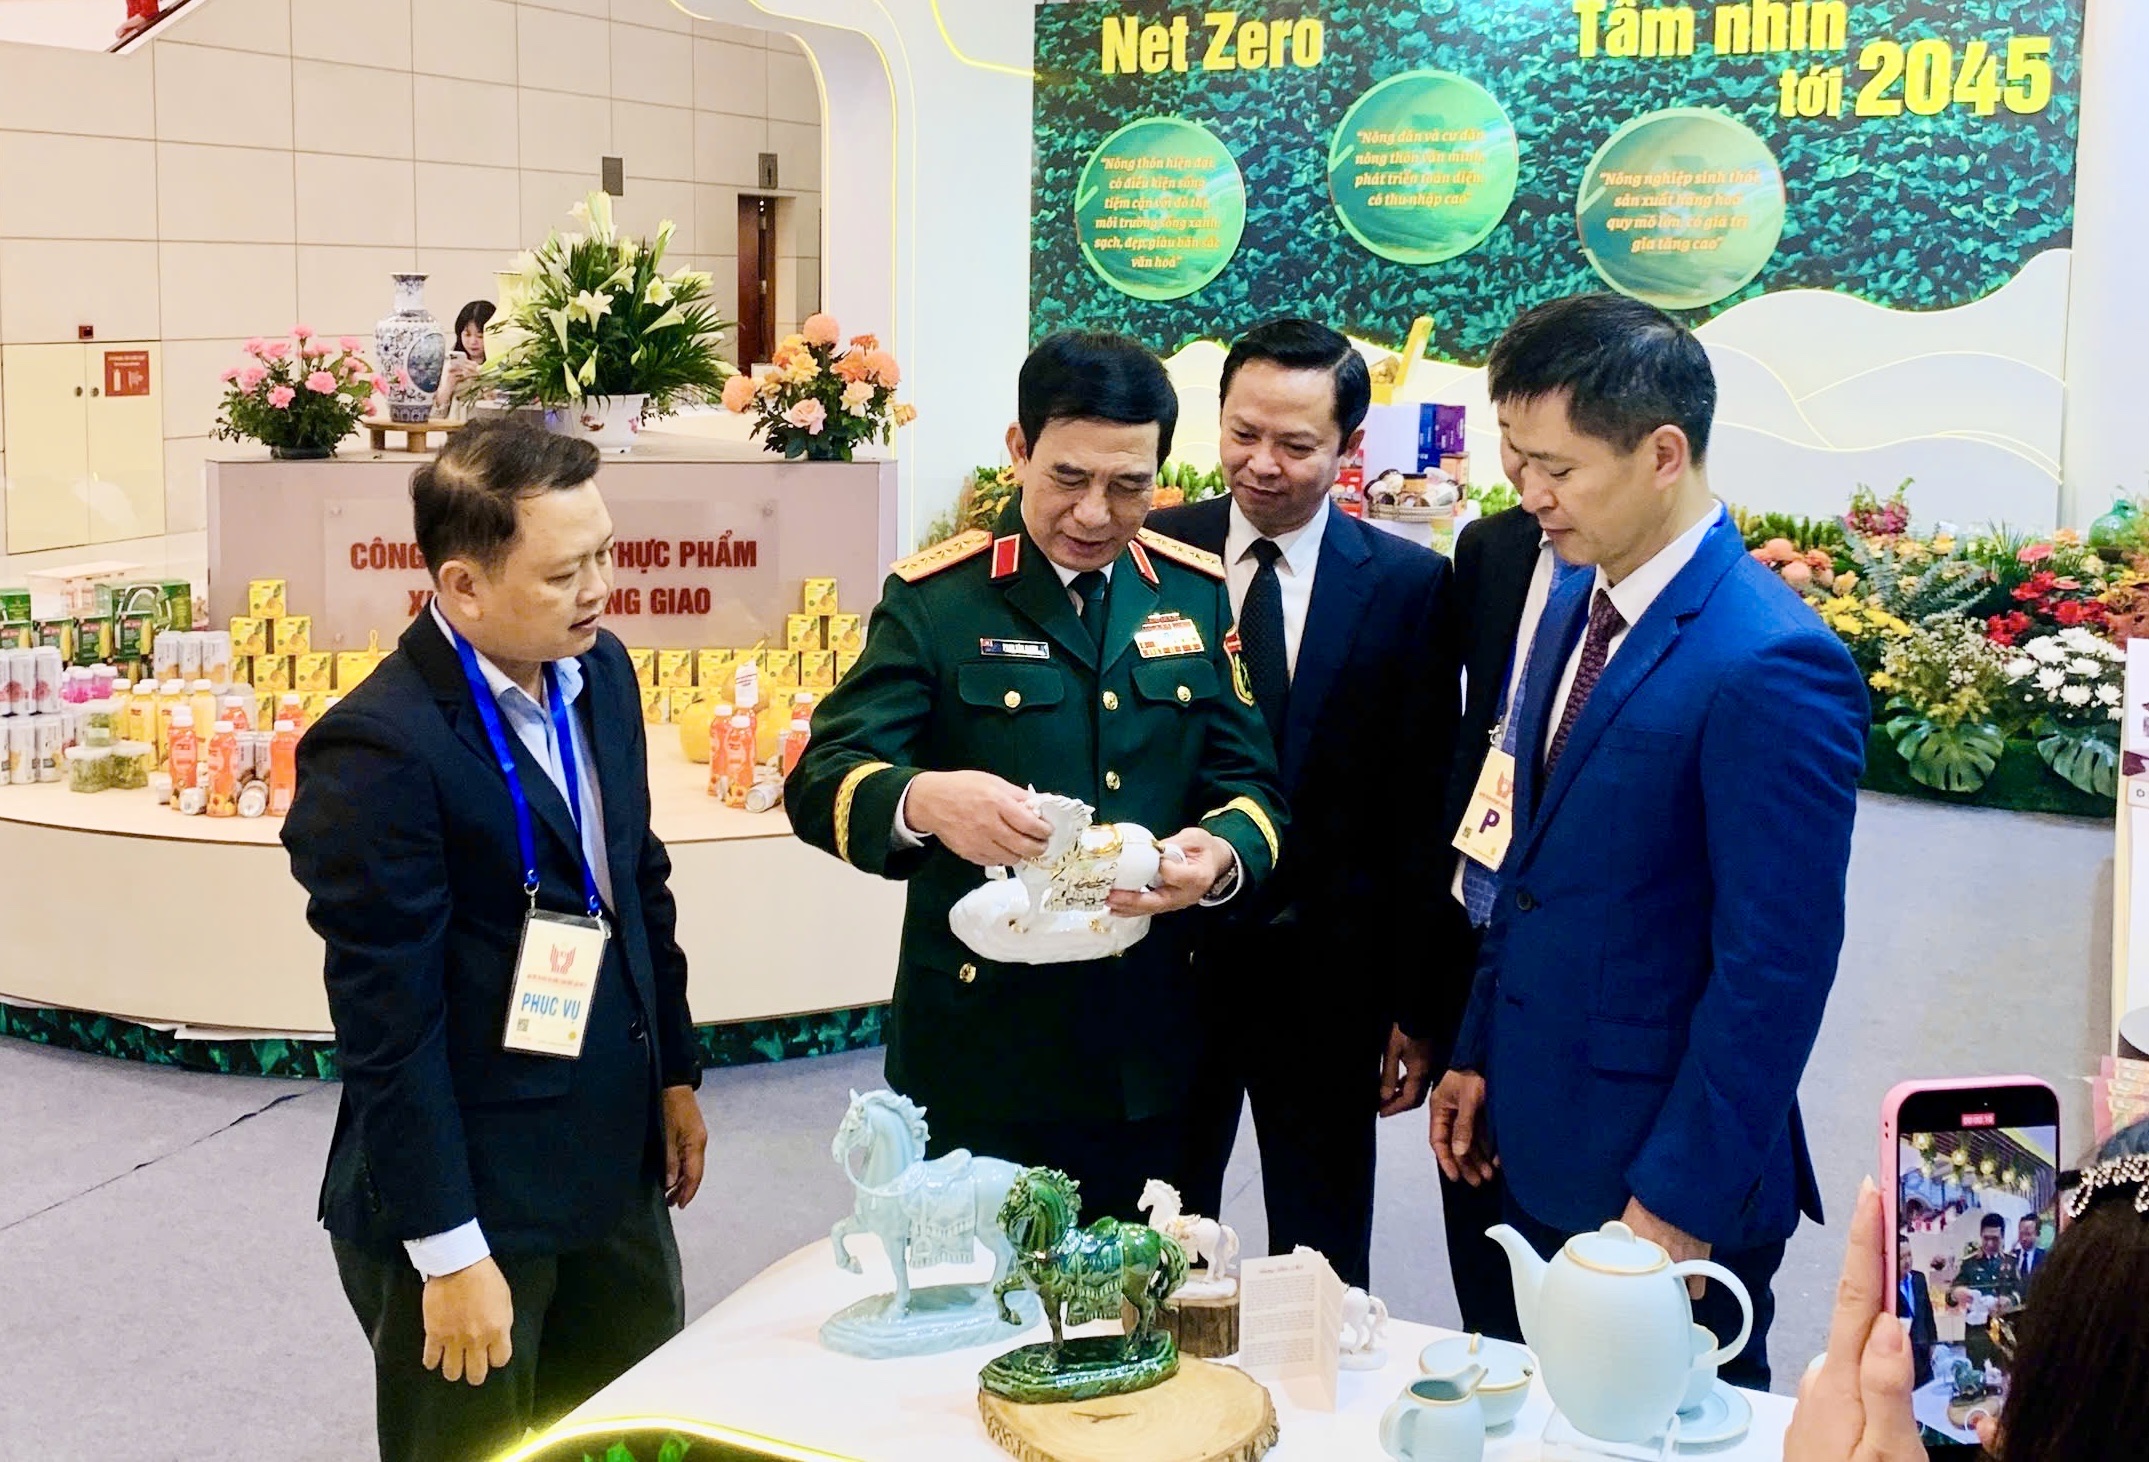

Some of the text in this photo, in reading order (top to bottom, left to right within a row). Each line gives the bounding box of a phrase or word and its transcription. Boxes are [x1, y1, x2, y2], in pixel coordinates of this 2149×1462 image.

[1101, 11, 1325, 74] Net Zero
[1778, 36, 2053, 117] tới 2045
[1424, 129, 1440, 142] và
[1354, 171, 1385, 189] phát
[1644, 170, 1693, 187] nghiệp
[1694, 171, 1725, 184] sinh
[1367, 192, 1382, 206] có
[1606, 216, 1632, 231] quy
[1633, 215, 1657, 228] mô
[1631, 237, 1655, 253] gia
[1657, 236, 1691, 253] tăng
[350, 537, 427, 570] CÔNG
[679, 529, 757, 568] PHẨM
[650, 587, 712, 616] GIAO
[521, 992, 581, 1025] PHỤC VỤ
